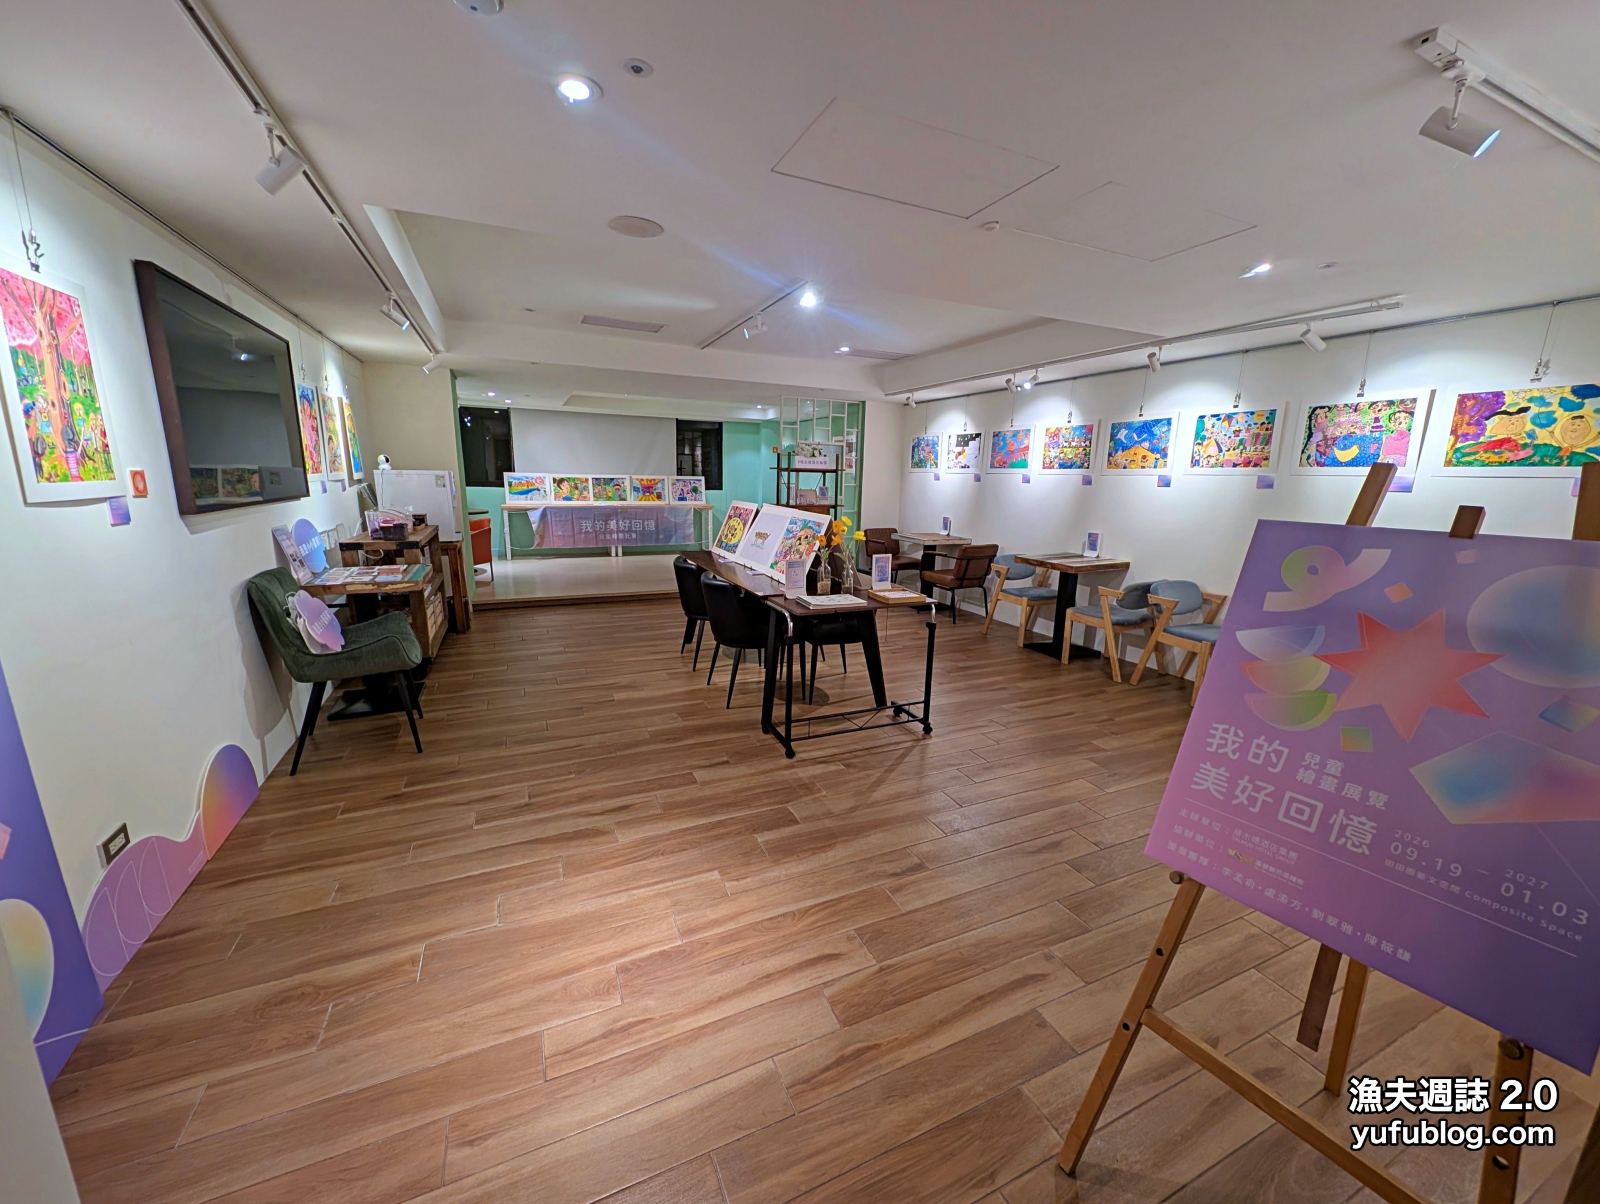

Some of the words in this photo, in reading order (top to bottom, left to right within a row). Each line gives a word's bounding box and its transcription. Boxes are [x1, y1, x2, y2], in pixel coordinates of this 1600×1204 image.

[580, 519, 656, 532] 我的美好回憶
[1206, 723, 1289, 773] 我的
[1301, 752, 1345, 777] 兒童
[1190, 761, 1378, 855] 美好回憶
[1295, 767, 1389, 810] 繪畫展覽
[1394, 830, 1430, 848] 2026
[1390, 841, 1462, 877] 09.19
[1500, 882, 1588, 926] 01.03
[1504, 869, 1548, 890] 2027
[1465, 890, 1535, 923] Composite
[1539, 919, 1583, 942] Space
